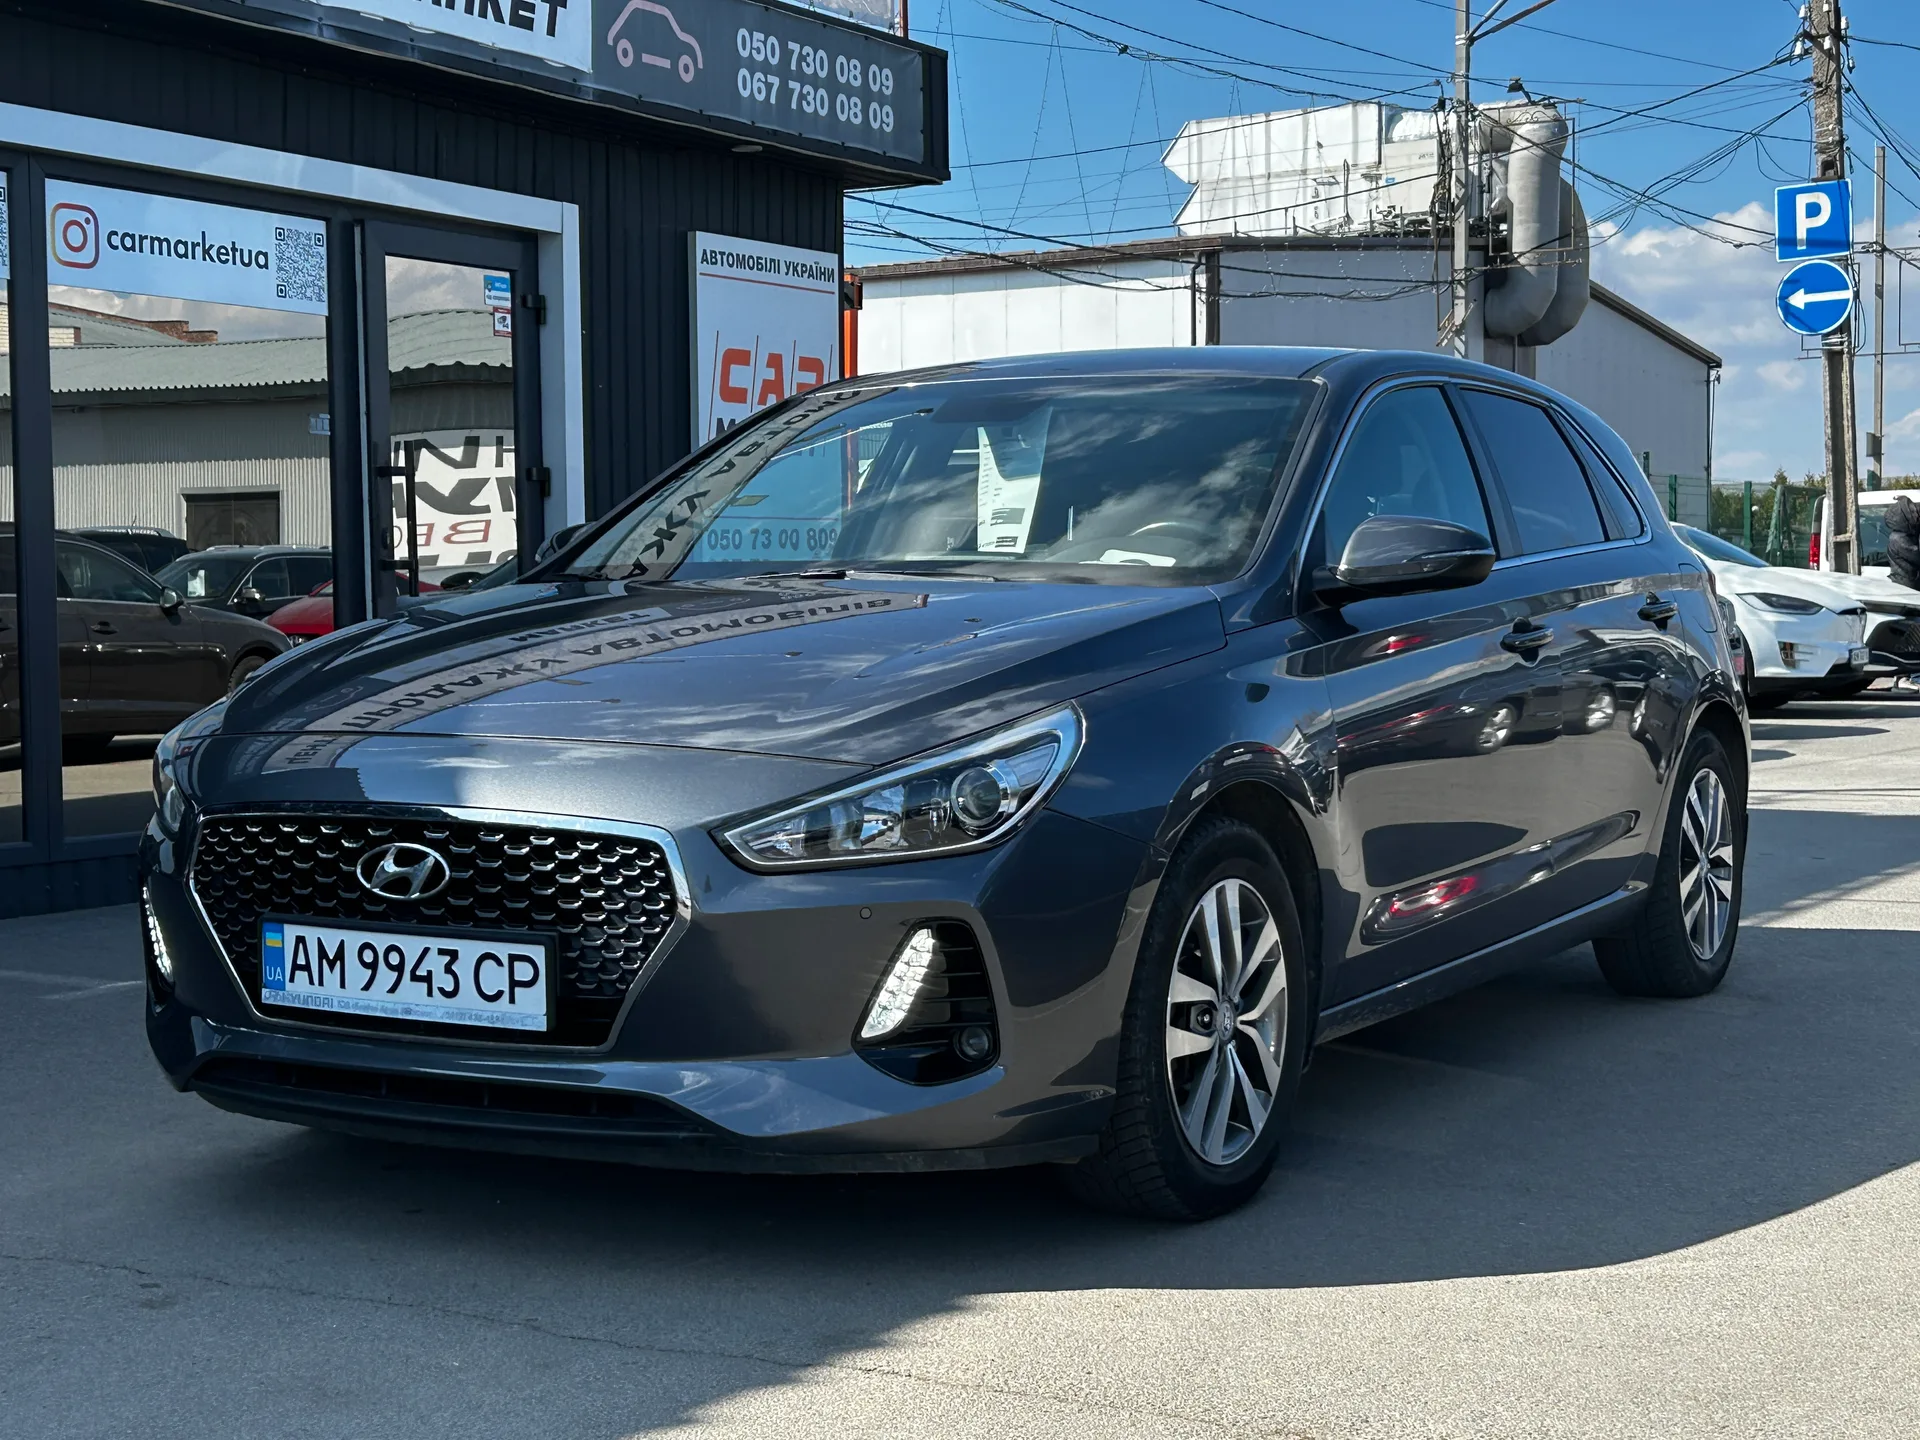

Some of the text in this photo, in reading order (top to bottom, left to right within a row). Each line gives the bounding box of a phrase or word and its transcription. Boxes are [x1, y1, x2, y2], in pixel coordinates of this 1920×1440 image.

[737, 28, 894, 95] 050 730 08 09
[737, 68, 894, 132] 067 730 08 09
[1796, 192, 1832, 250] P
[106, 230, 269, 270] carmarketua
[700, 249, 835, 283] АВТОМОБІЛІ УКРАЇНИ
[707, 528, 743, 551] 050
[750, 528, 772, 550] 73
[266, 965, 283, 983] UA
[289, 934, 540, 1005] AM 9943 CP
